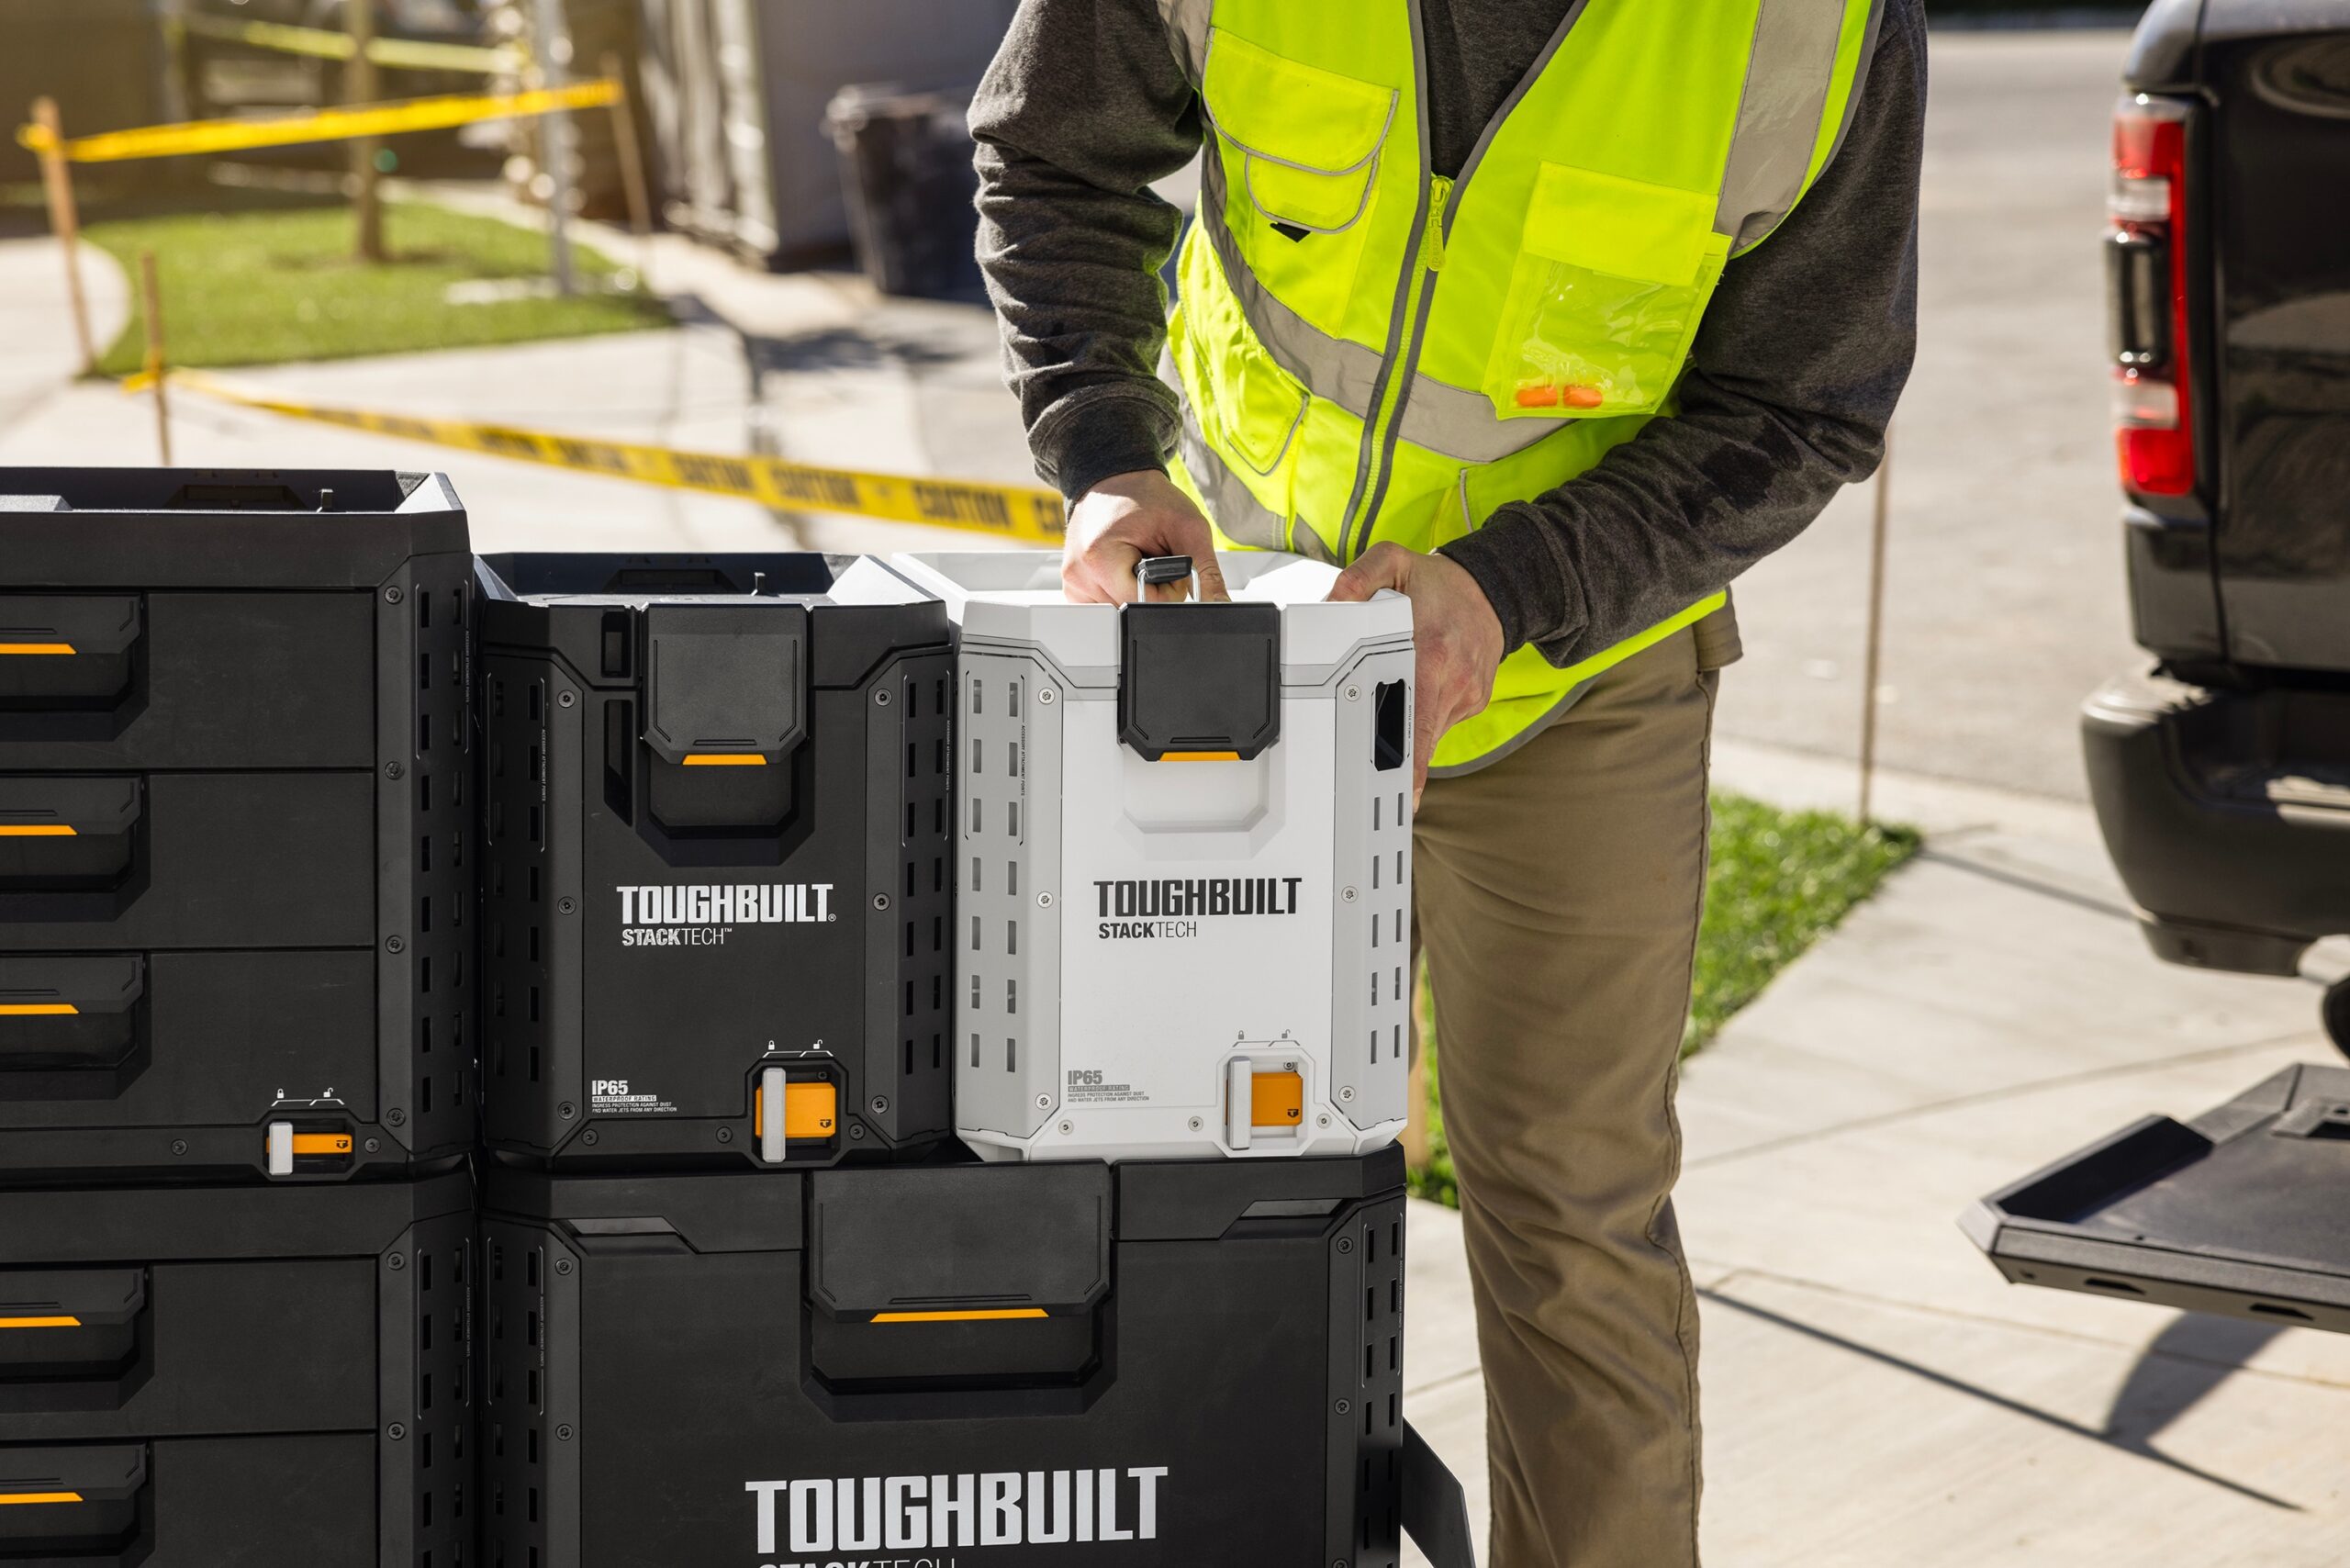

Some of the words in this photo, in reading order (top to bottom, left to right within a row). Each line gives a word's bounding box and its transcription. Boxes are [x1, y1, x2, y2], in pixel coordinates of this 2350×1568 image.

[1093, 878, 1303, 917] TOUGHBUILT
[1098, 922, 1197, 939] STACKTECH
[1068, 1070, 1102, 1085] IP65
[591, 1080, 629, 1095] IP65
[745, 1466, 1169, 1554] TOUGHBUILT
